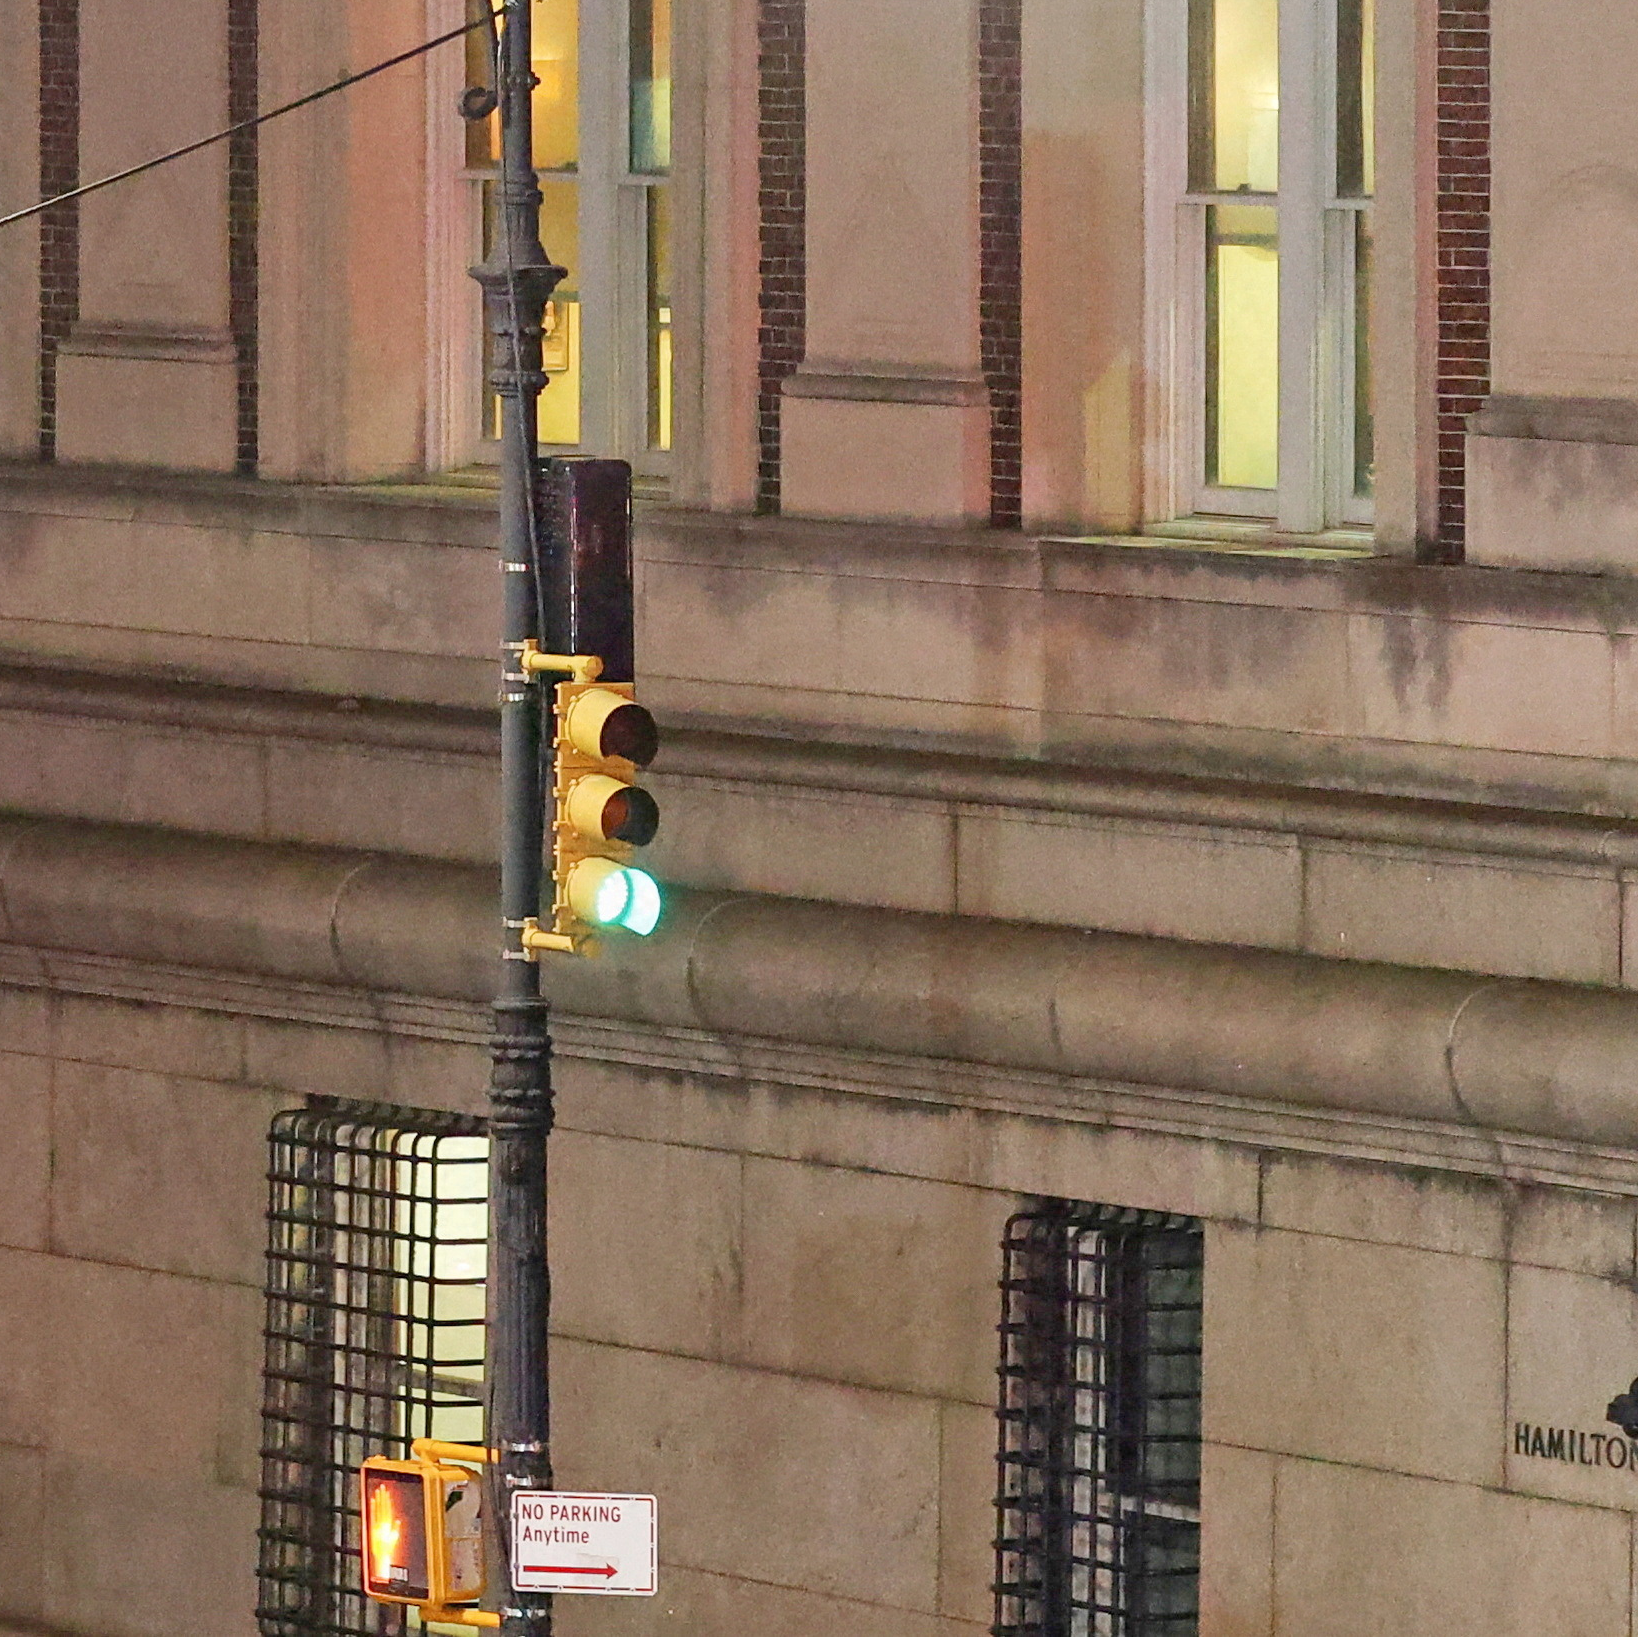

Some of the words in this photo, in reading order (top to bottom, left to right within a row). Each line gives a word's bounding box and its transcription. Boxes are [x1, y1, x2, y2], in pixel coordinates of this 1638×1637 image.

[522, 1504, 543, 1520] NO
[550, 1504, 621, 1523] PARKING
[523, 1525, 590, 1545] Anytime
